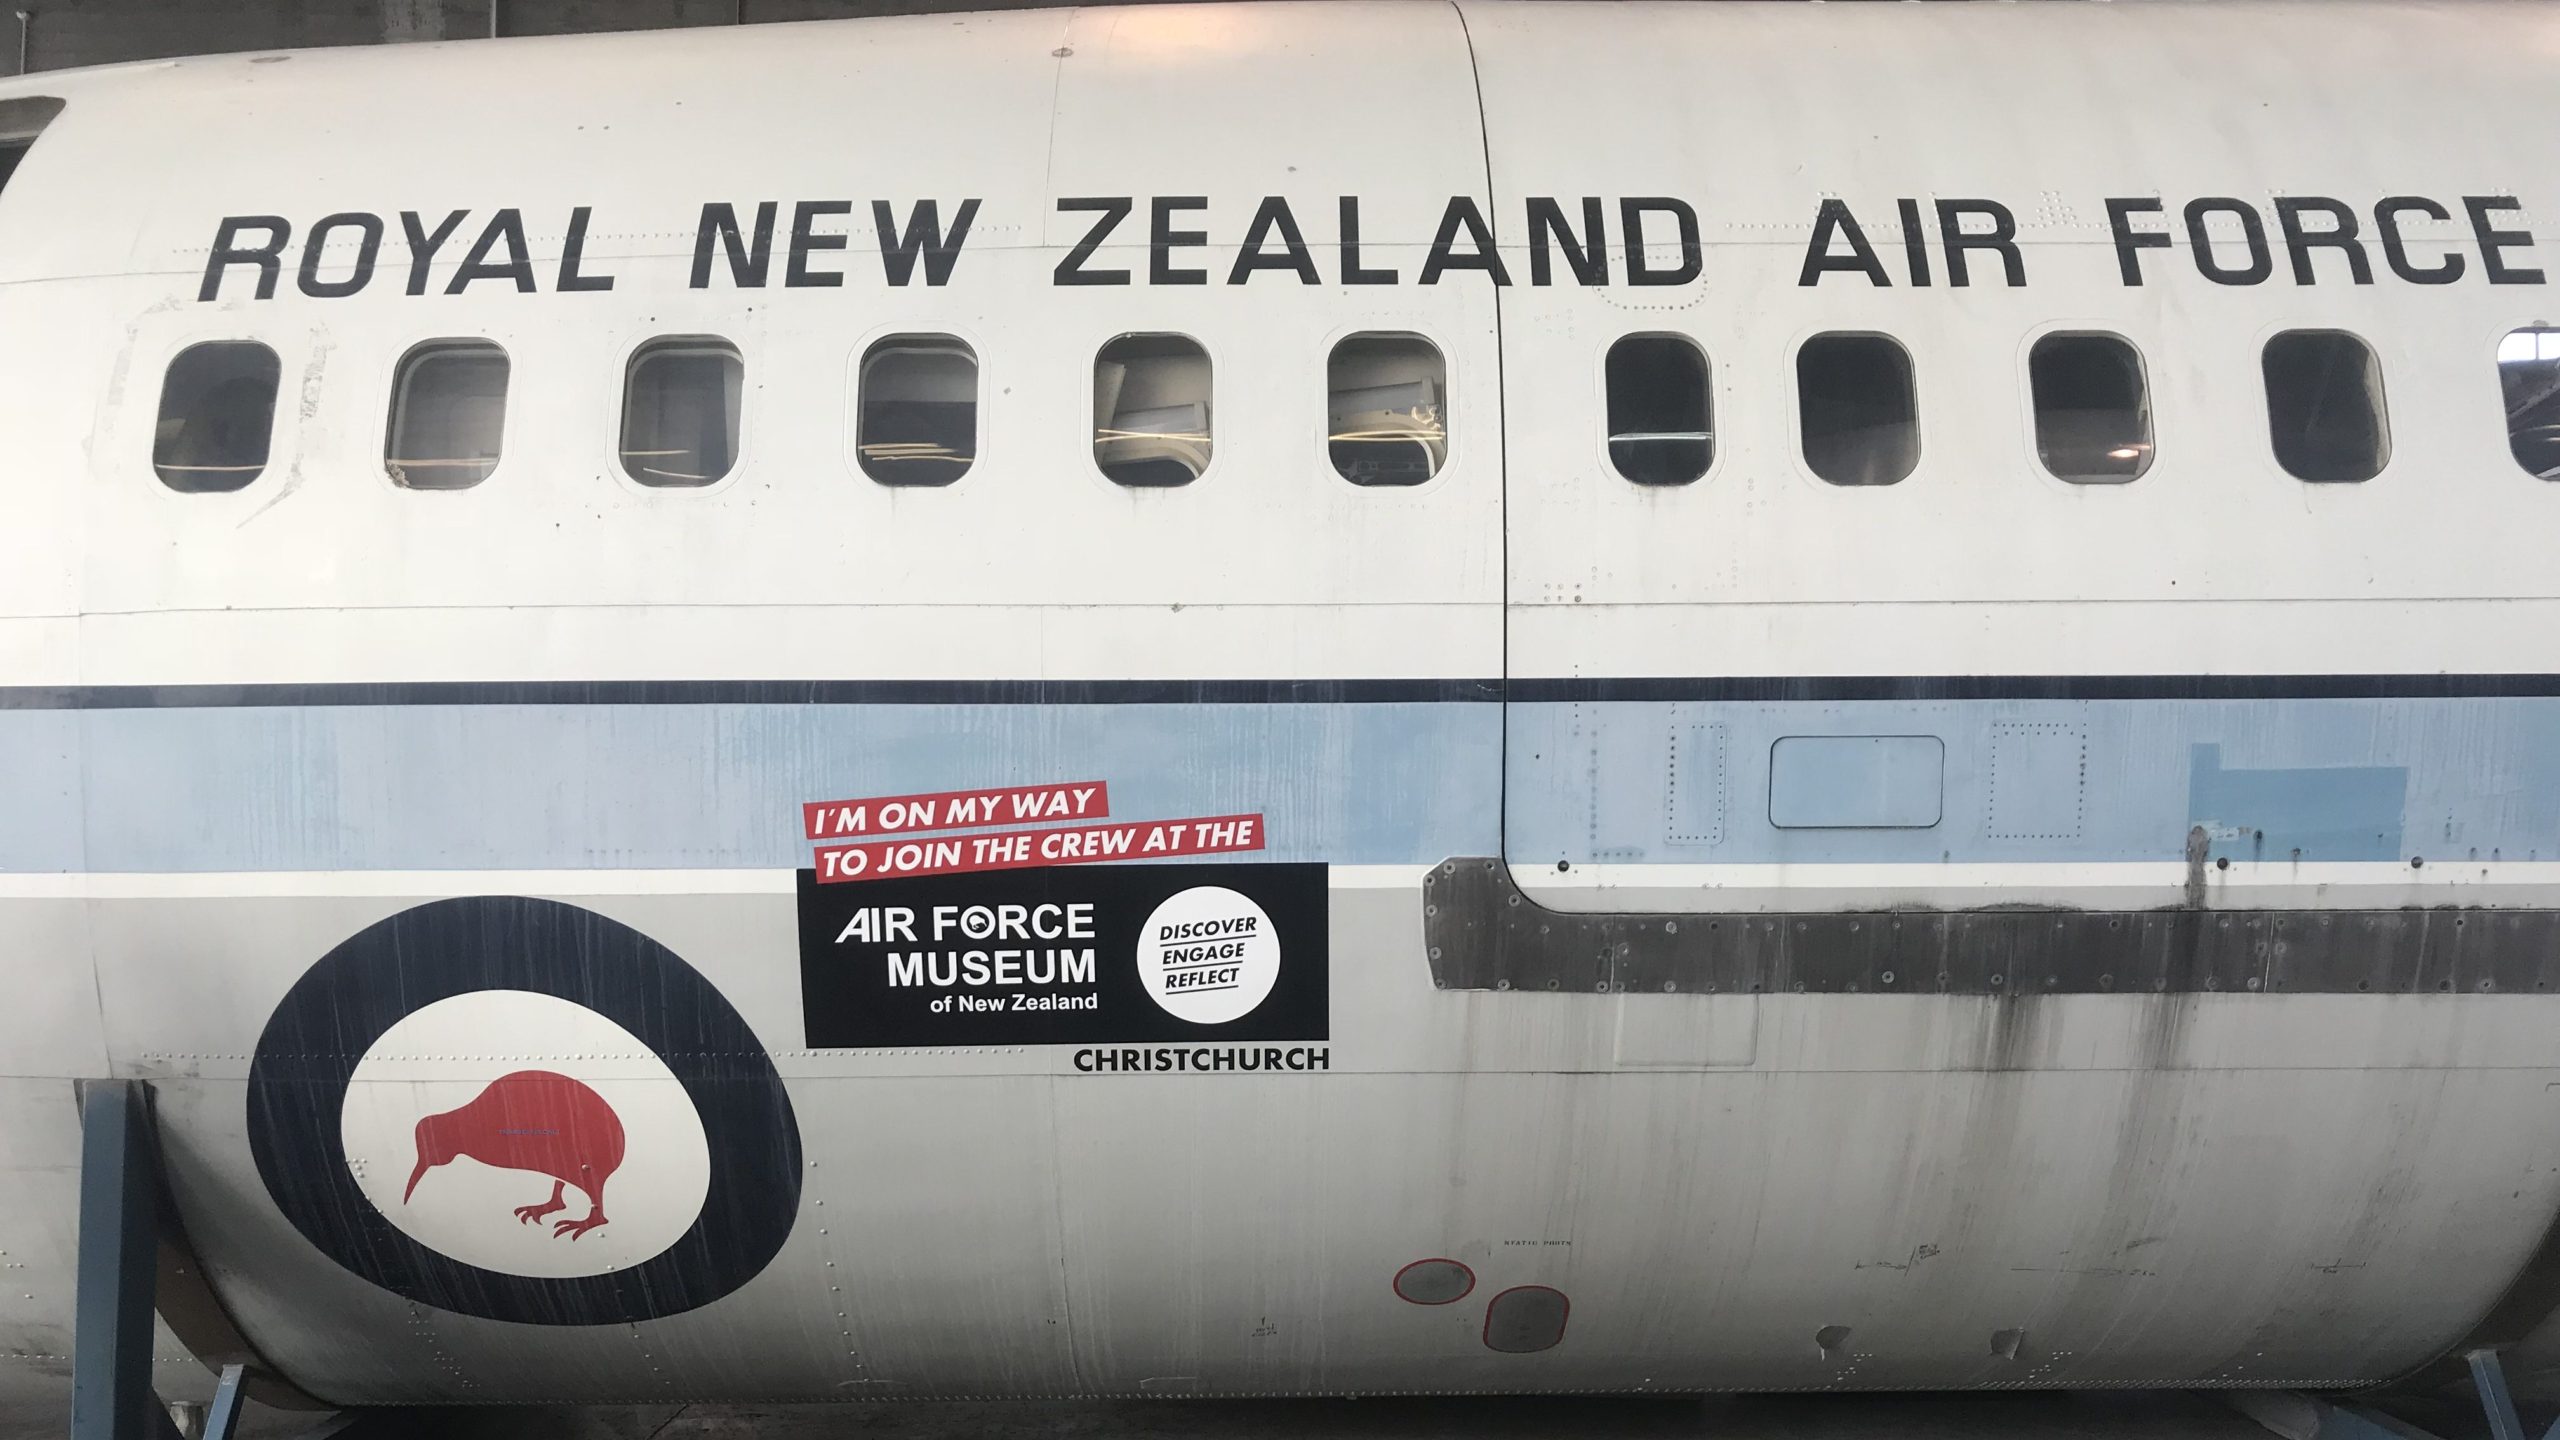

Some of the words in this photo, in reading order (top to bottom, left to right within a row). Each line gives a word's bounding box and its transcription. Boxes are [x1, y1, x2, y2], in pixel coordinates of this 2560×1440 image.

[198, 207, 615, 302] ROYAL
[690, 198, 982, 289] NEW
[1053, 196, 1703, 287] ZEALAND
[1798, 198, 2027, 288] AIR
[2104, 195, 2547, 287] FORCE
[814, 807, 866, 835] I'M
[878, 800, 936, 830] ON
[945, 795, 1003, 824] MY
[1011, 787, 1096, 819] WAY
[823, 849, 868, 877] TO
[876, 841, 962, 873] JOIN
[972, 835, 1032, 864] THE
[1040, 828, 1137, 860] CREW
[1142, 824, 1187, 852] AT
[1195, 820, 1254, 848] THE
[834, 907, 918, 944] AIR
[932, 903, 1096, 941] FORCE
[1159, 916, 1257, 941] DISCOVER
[887, 948, 1096, 987] MUSEUM
[1162, 942, 1245, 965] ENGAGE
[1165, 967, 1240, 989] REFLECT
[930, 995, 953, 1013] of
[958, 994, 1006, 1012] New
[1011, 992, 1098, 1011] Zealand
[1073, 1047, 1330, 1072] CHRISTCHURCH
